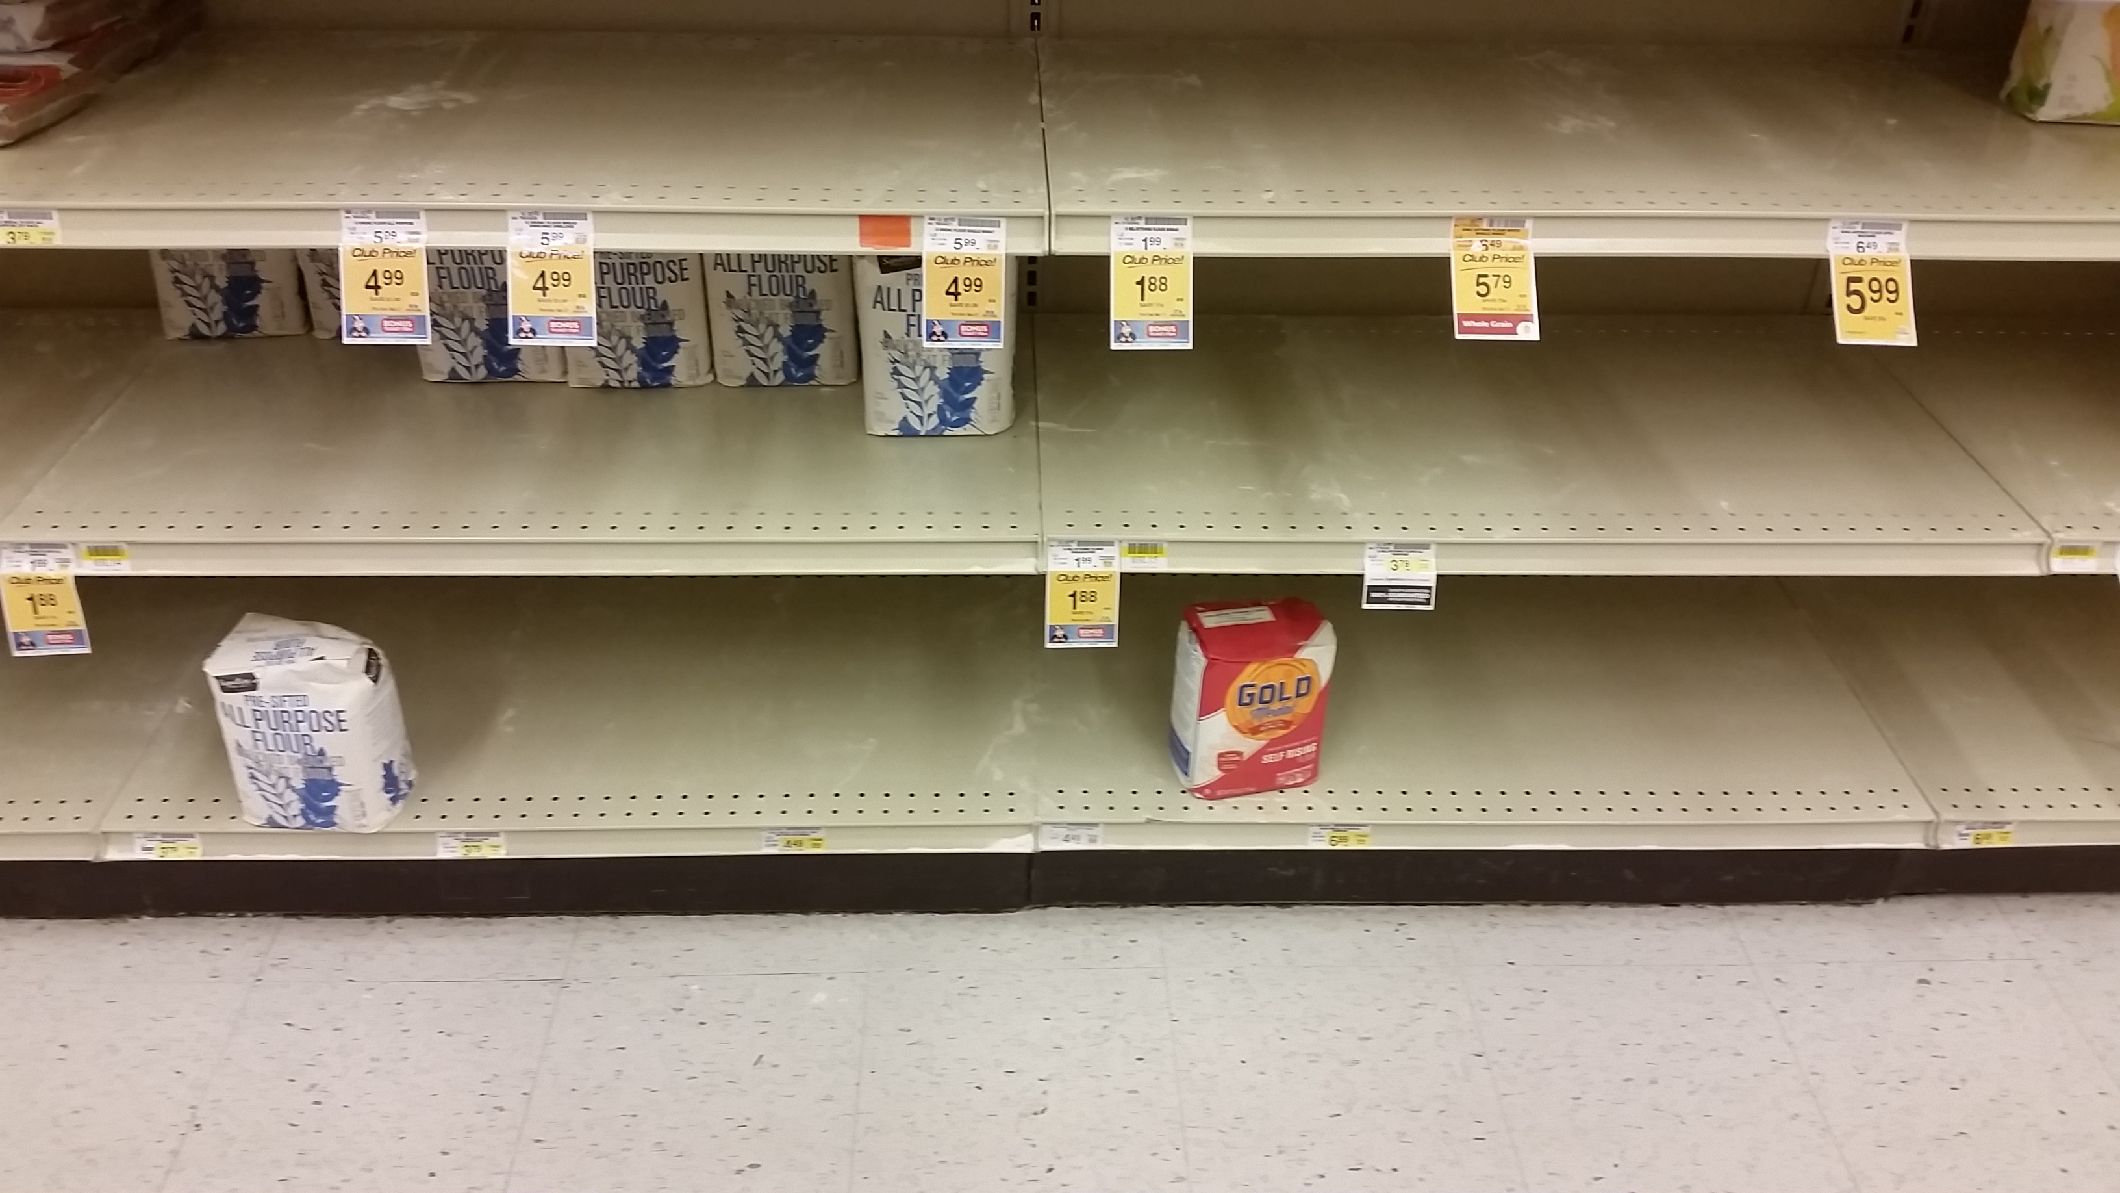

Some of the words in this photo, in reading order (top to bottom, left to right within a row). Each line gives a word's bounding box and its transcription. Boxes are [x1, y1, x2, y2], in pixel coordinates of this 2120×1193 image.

[352, 248, 379, 258] Club
[382, 248, 417, 258] Price!
[437, 250, 507, 265] PURPO
[713, 253, 748, 272] ALL
[749, 253, 838, 274] PURPOSE
[934, 255, 960, 265] Club
[963, 256, 997, 267] Price!
[1122, 255, 1149, 265] Club
[1151, 255, 1184, 265] Price!
[1462, 253, 1489, 263] Club
[1491, 253, 1525, 263] Price!
[1842, 256, 1867, 266] Club
[1870, 257, 1902, 267] Price!
[364, 269, 404, 296] 499
[435, 266, 500, 291] FLOUR
[532, 270, 572, 297] 499
[599, 257, 690, 286] PURPOSE
[746, 273, 808, 299] FLOUR
[945, 276, 984, 302] 499
[1135, 275, 1168, 302] 188
[1475, 273, 1513, 298] 579
[1846, 276, 1899, 315] 599
[597, 286, 659, 311] FLOUR
[872, 285, 907, 312] ALL
[1490, 320, 1514, 328] Grain
[1056, 573, 1080, 582] Club
[1083, 573, 1113, 582] Price!
[1068, 590, 1098, 610] 188
[1237, 675, 1313, 707] GOLD
[251, 708, 349, 733] PURPOSE
[251, 730, 318, 756] FLOUR
[1261, 751, 1285, 763] SELF
[1286, 742, 1318, 758] RISING
